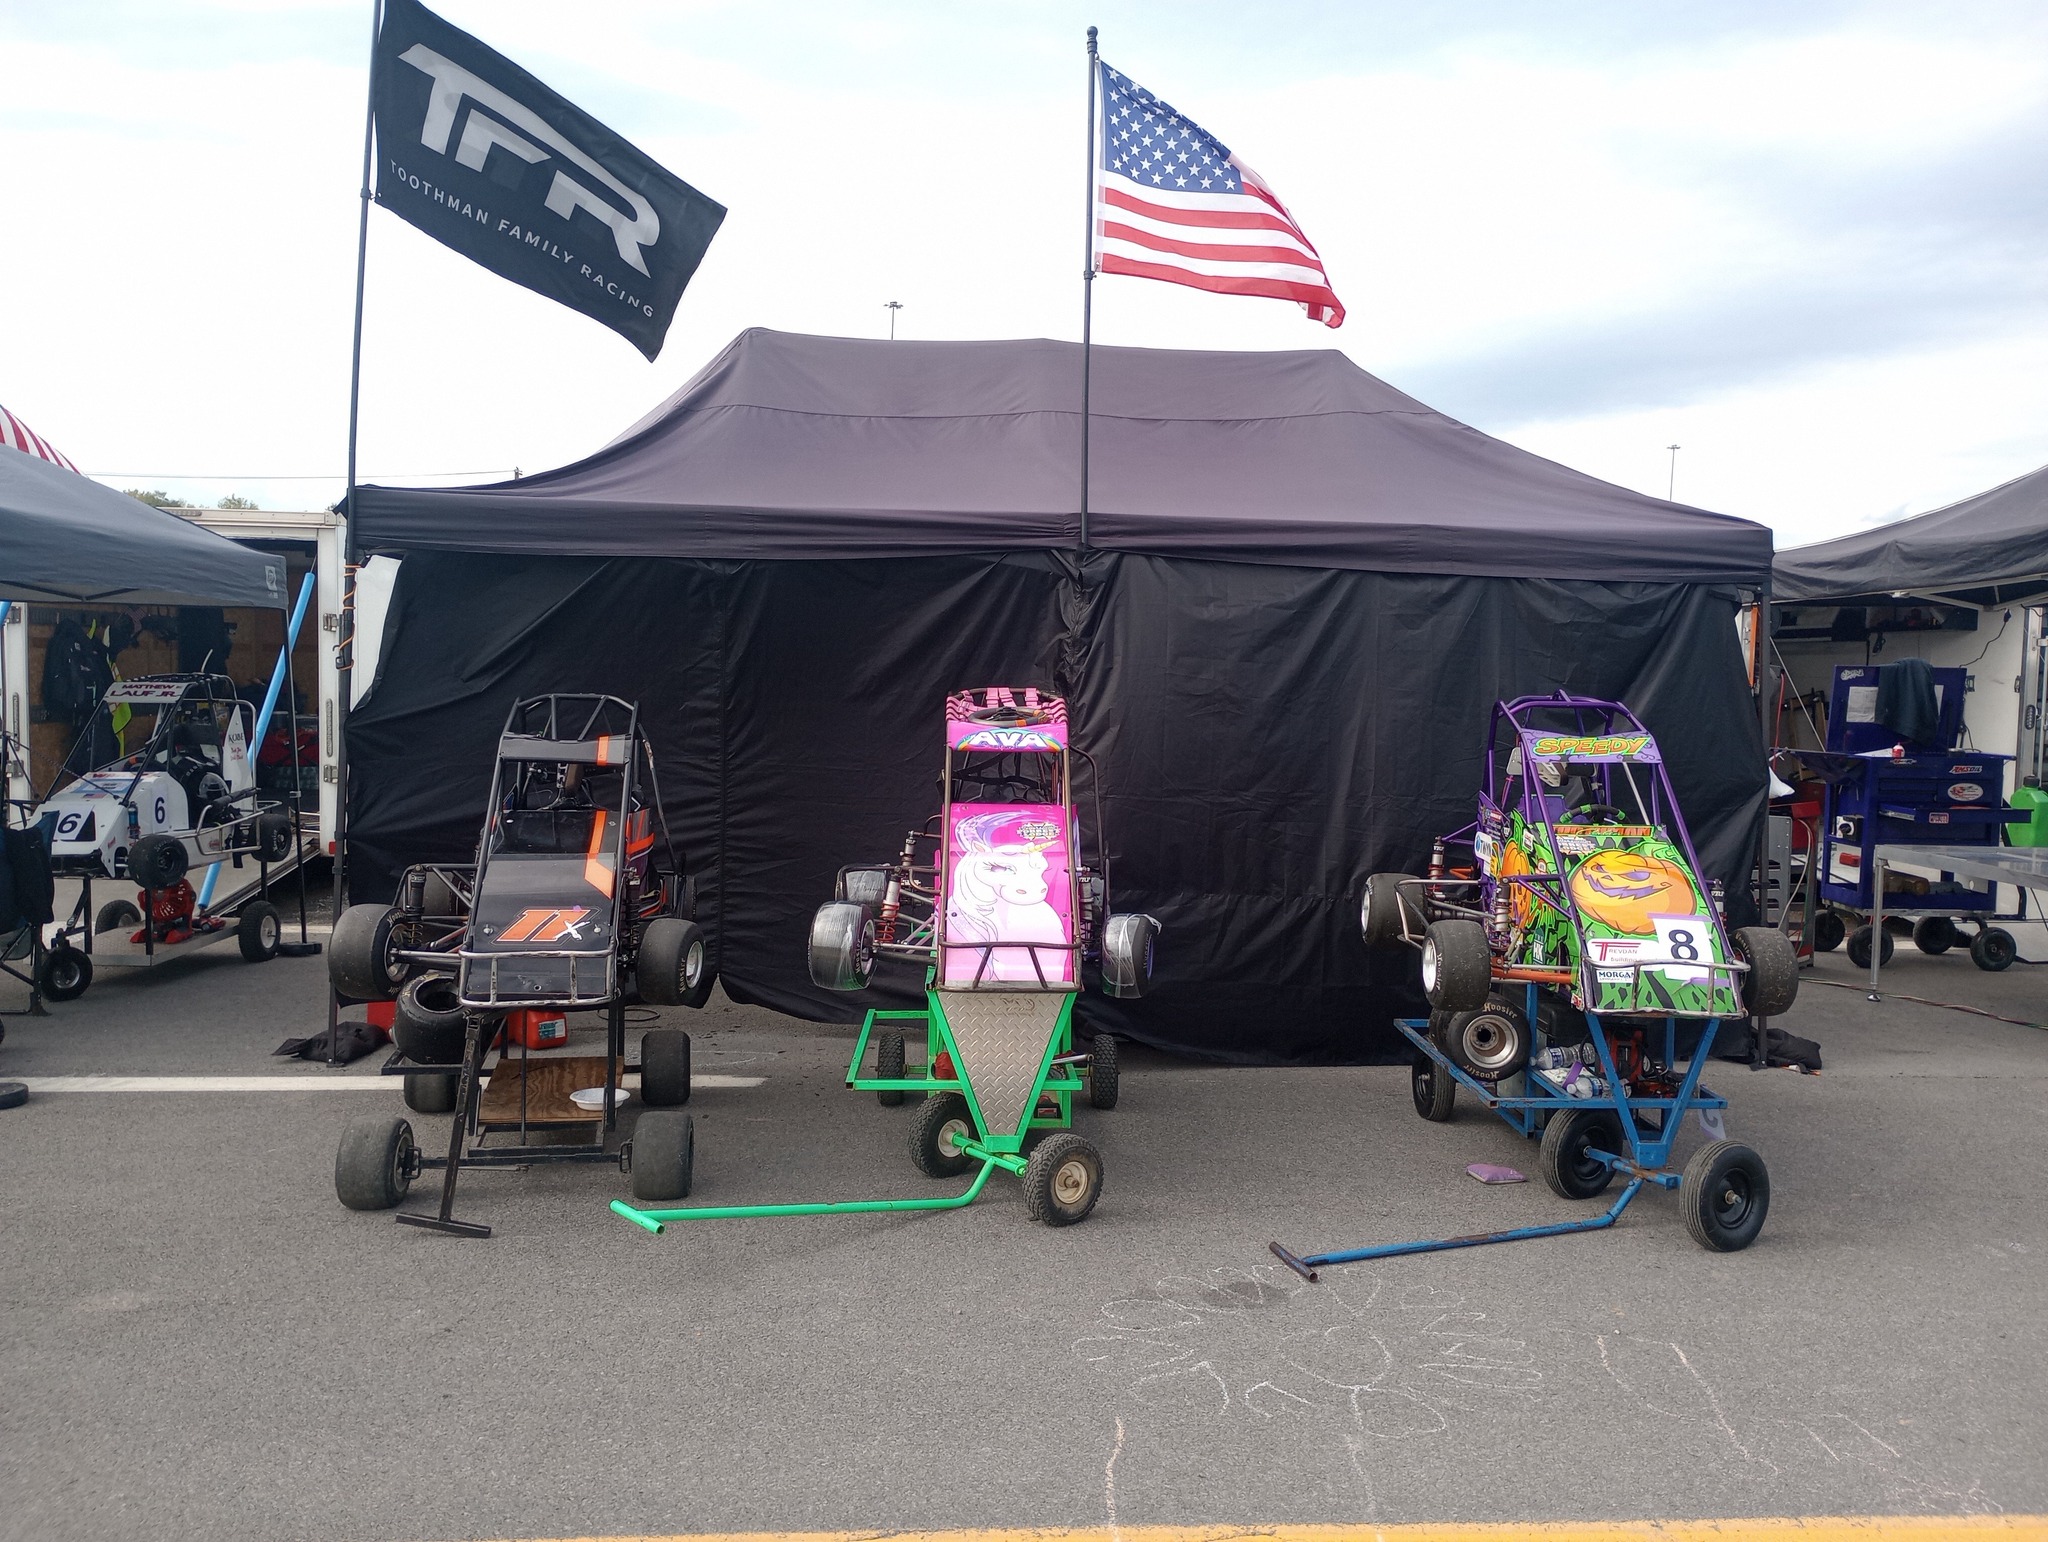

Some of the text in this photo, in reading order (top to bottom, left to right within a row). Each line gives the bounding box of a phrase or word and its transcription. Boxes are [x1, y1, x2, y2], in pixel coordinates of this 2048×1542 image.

[397, 42, 661, 279] TFR
[389, 158, 655, 319] TOOTHMAN FAMILY RACING
[968, 731, 1049, 748] AVA
[1534, 737, 1650, 756] SPEEDY
[155, 797, 166, 824] 6
[57, 813, 82, 834] 6
[1668, 929, 1699, 961] 8
[1482, 1002, 1518, 1019] Hoosier
[1463, 1064, 1500, 1079] Hoosier
